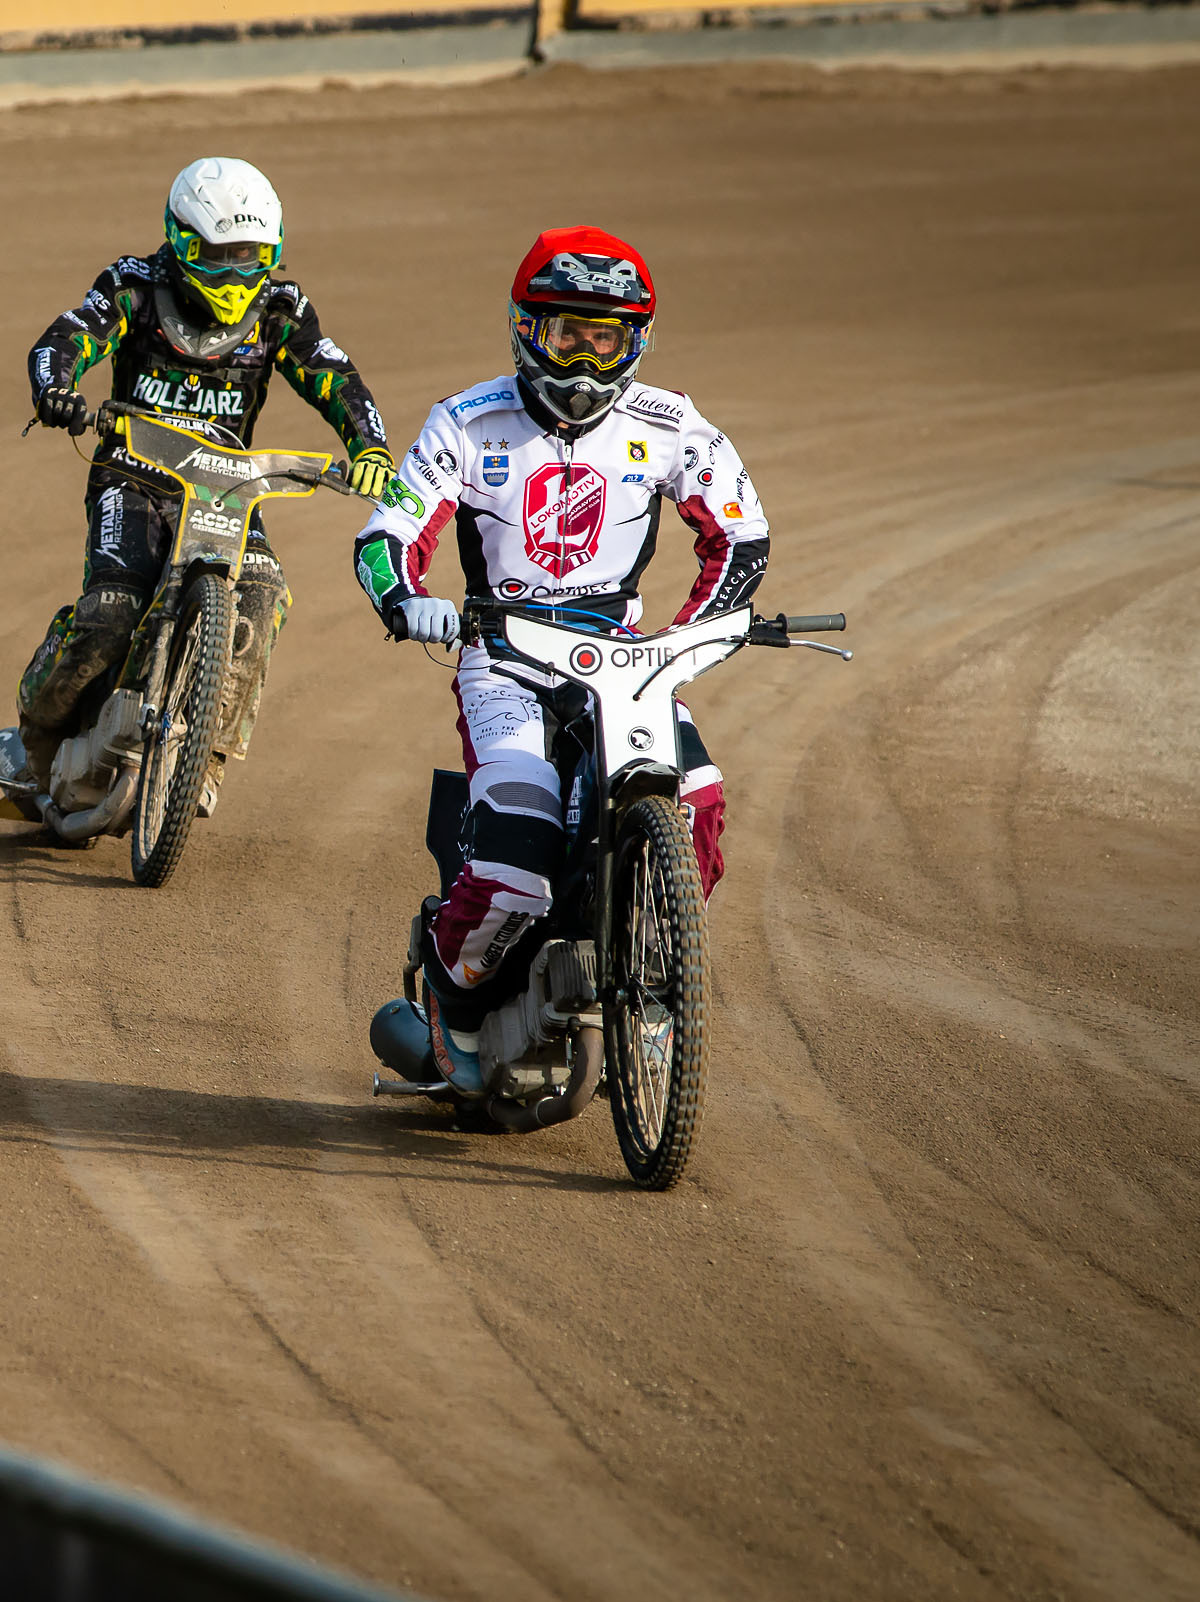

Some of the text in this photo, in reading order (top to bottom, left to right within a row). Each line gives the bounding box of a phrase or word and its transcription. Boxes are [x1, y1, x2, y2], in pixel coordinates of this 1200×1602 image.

[234, 213, 267, 228] DPV
[132, 373, 244, 416] KOLEJARZ
[450, 390, 515, 419] TRODO
[175, 446, 272, 492] METALIKA
[198, 463, 251, 481] RECYCLING
[114, 493, 124, 544] RECYCLING
[530, 475, 596, 529] LOKOMOTIV
[95, 482, 128, 568] METALIKA
[189, 509, 242, 533] ACDC
[242, 552, 280, 571] DPV
[100, 590, 143, 610] DPV
[715, 569, 747, 609] BEACH
